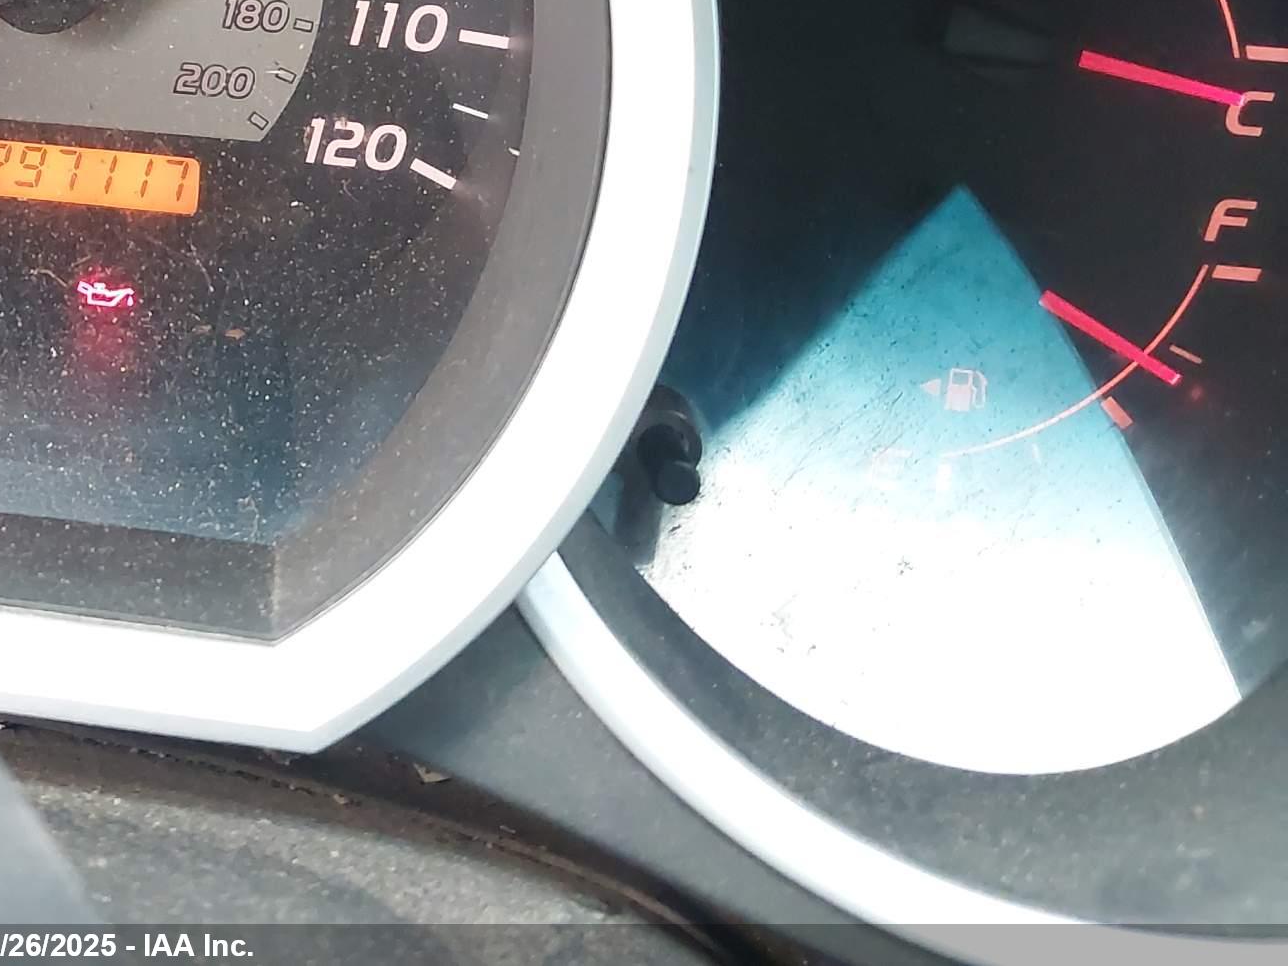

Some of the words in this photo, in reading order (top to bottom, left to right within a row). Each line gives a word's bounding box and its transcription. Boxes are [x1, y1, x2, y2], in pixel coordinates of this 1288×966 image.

[349, 0, 448, 53] 110
[173, 63, 255, 99] 200
[1225, 91, 1276, 137] C
[304, 116, 407, 172] 120
[1204, 198, 1258, 242] F
